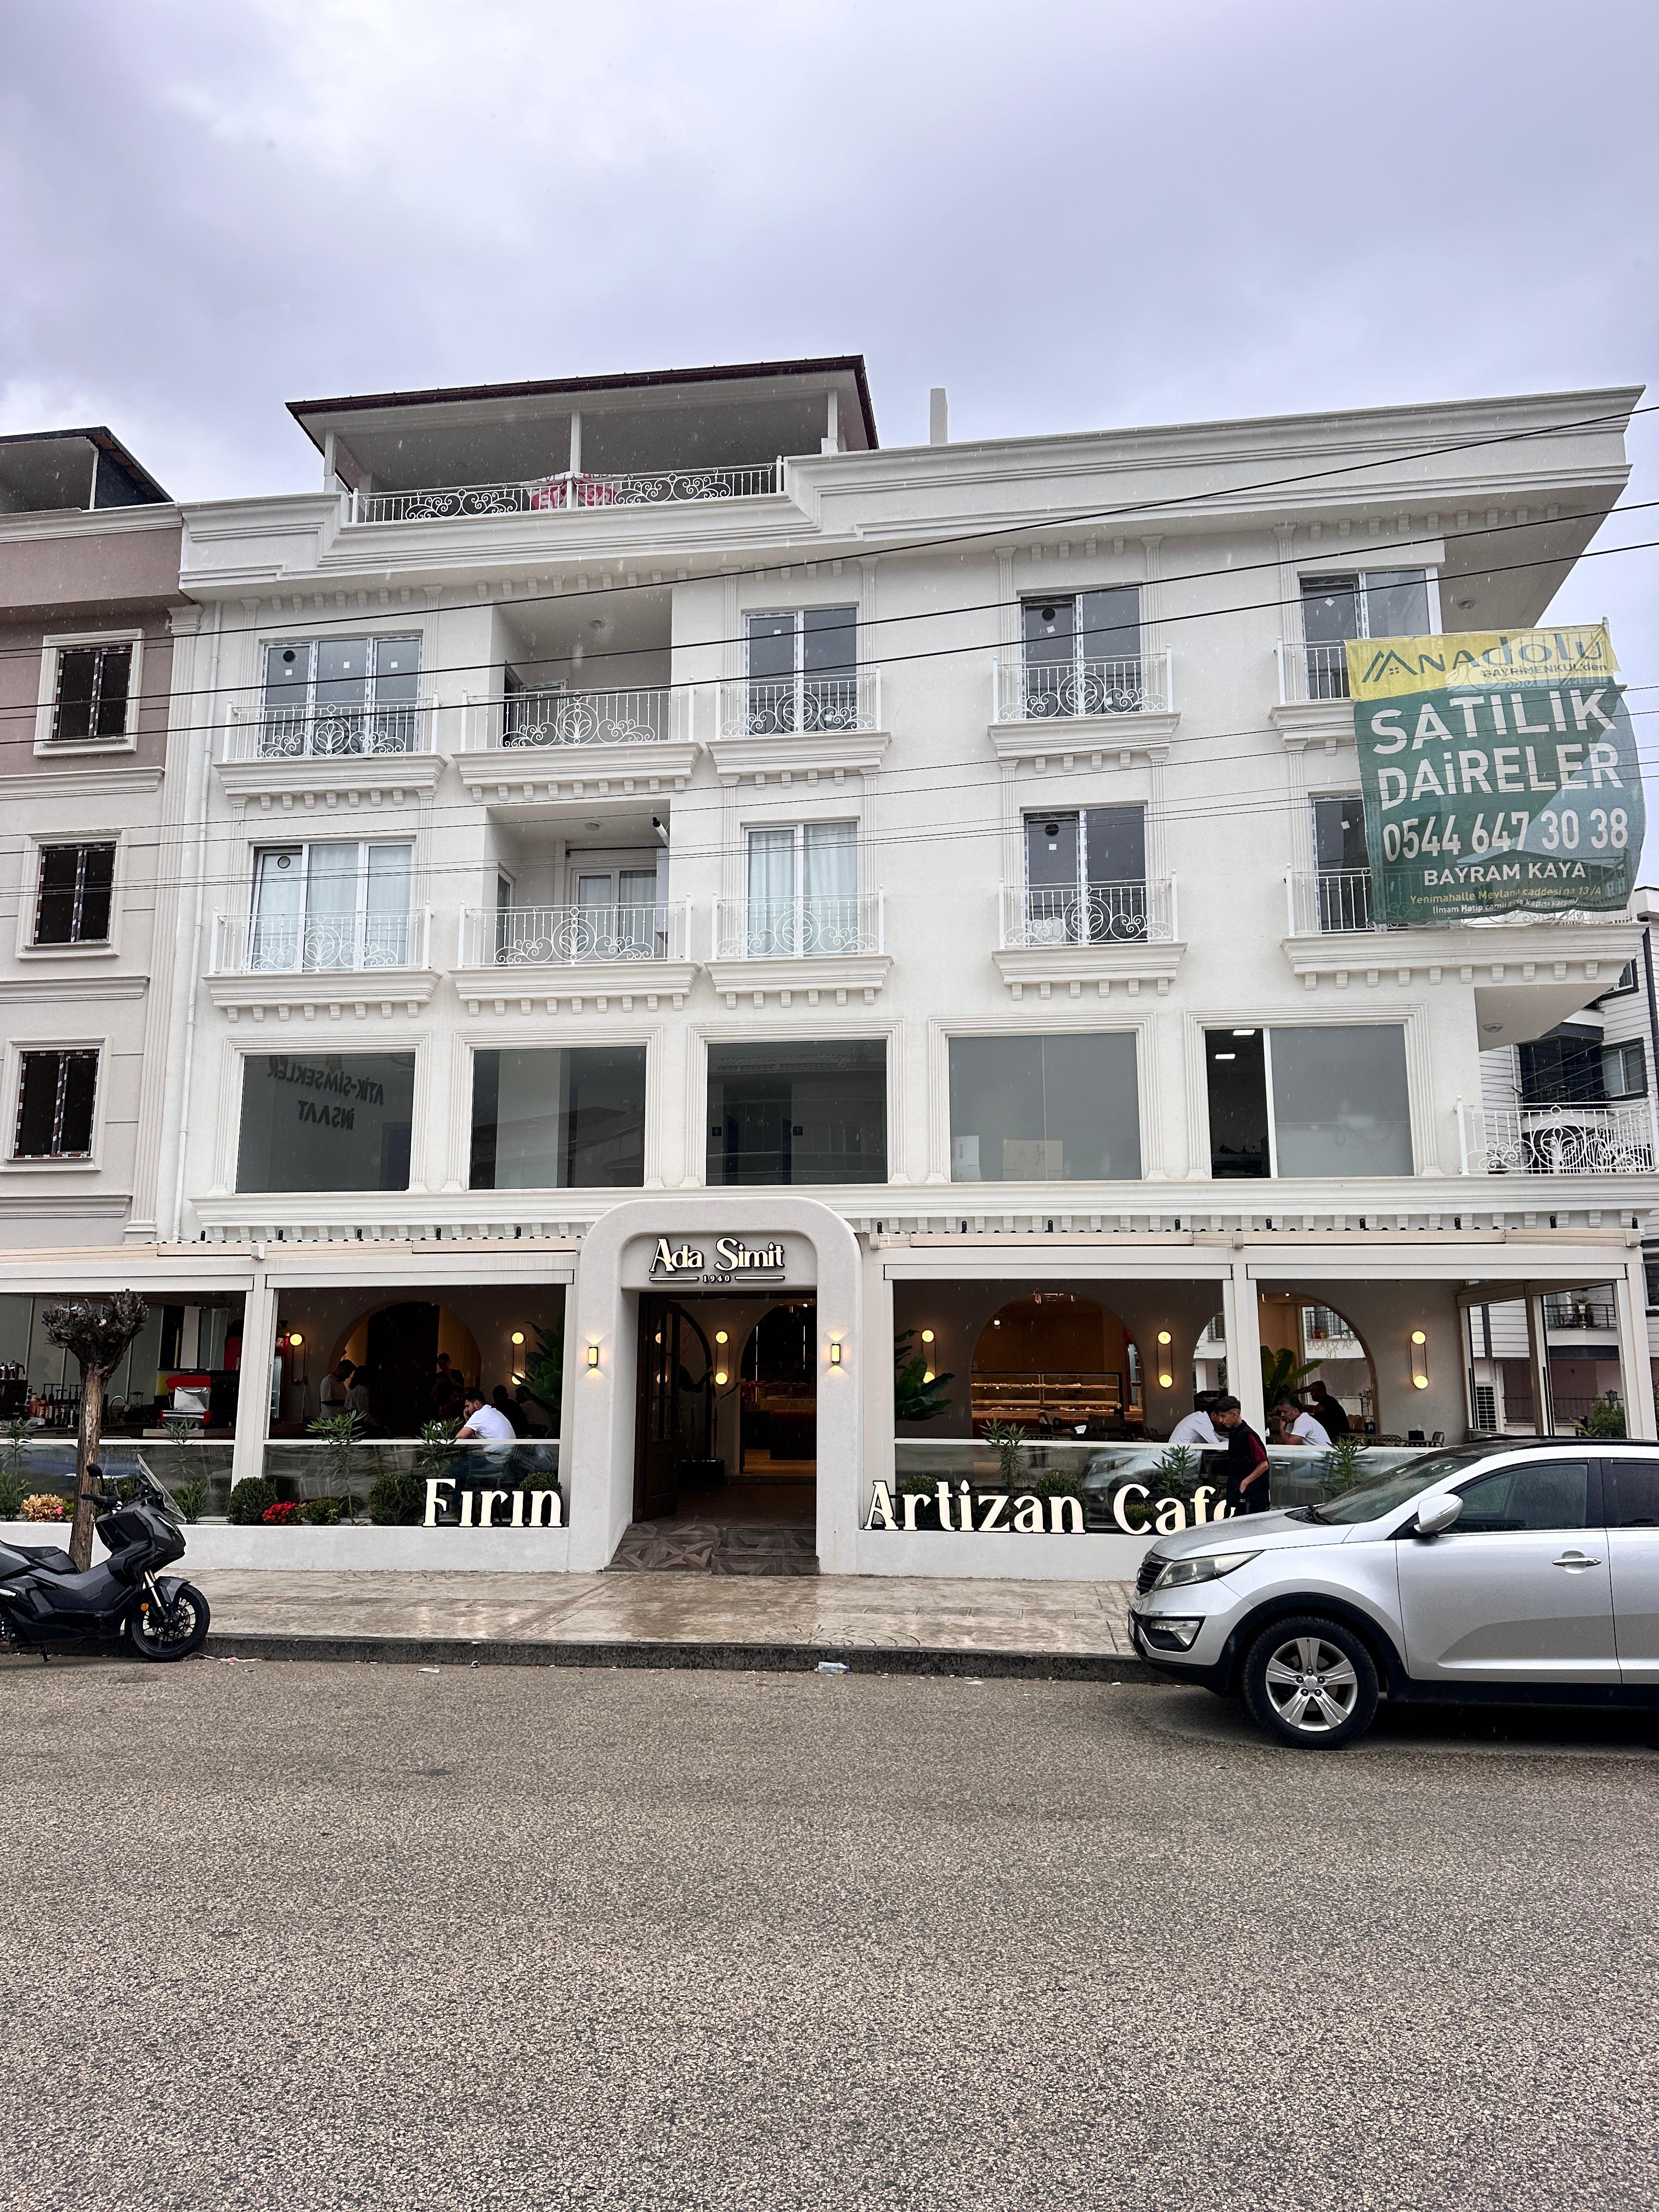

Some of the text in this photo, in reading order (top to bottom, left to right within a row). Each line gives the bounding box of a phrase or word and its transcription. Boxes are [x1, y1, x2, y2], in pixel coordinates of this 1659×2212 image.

[1371, 689, 1617, 755] SATILIK
[1383, 807, 1629, 862] 0544 647 30 38
[1410, 891, 1475, 904] Yenimahalle
[1522, 886, 1561, 896] caddesi
[1424, 862, 1587, 886] BAYRAM KAYA
[648, 1237, 785, 1273] Ada Simit
[702, 1274, 731, 1283] 1940
[422, 1478, 563, 1527] Fırın
[864, 1479, 1087, 1534] Artizan
